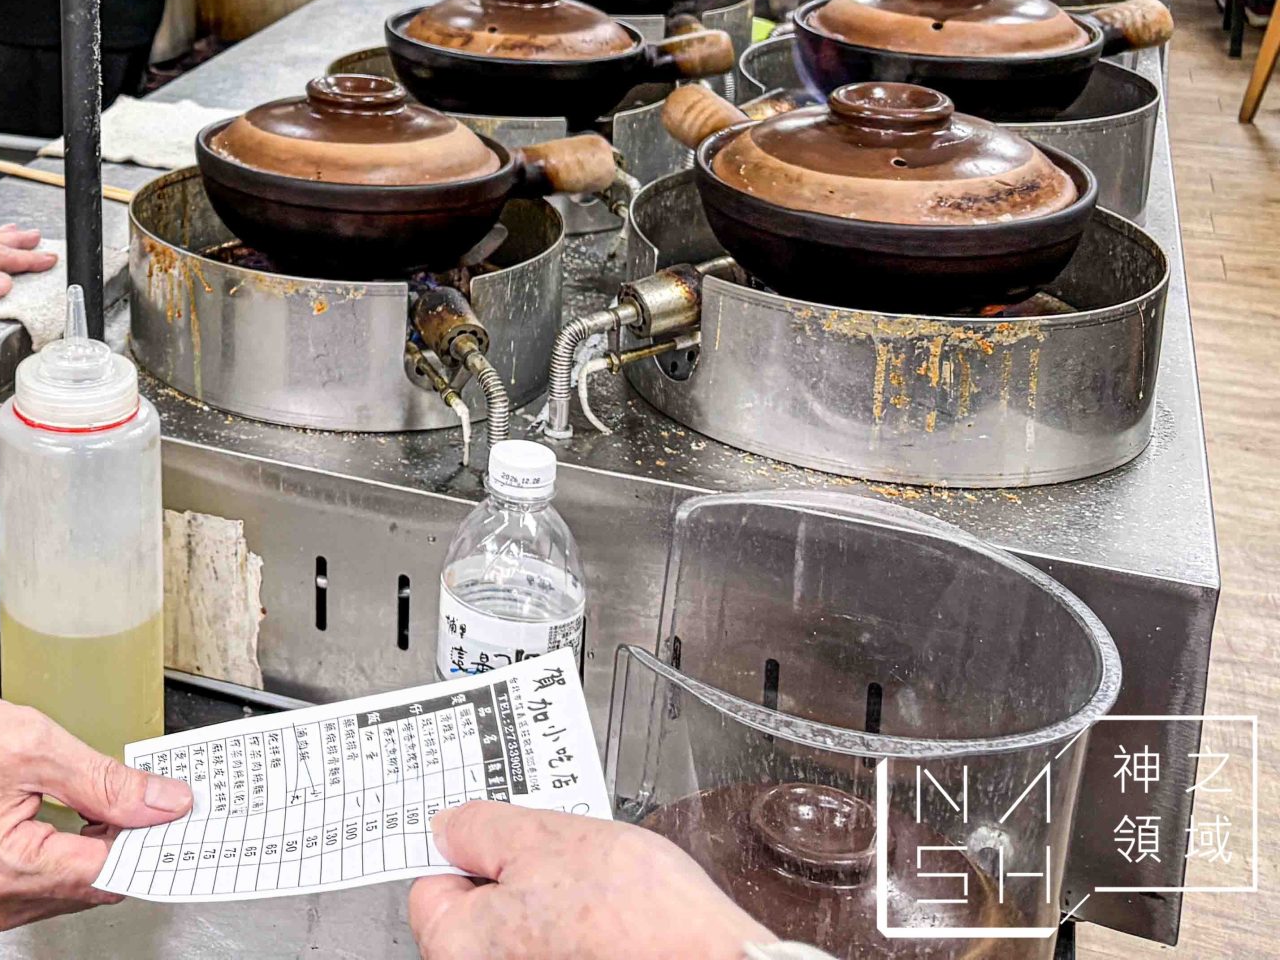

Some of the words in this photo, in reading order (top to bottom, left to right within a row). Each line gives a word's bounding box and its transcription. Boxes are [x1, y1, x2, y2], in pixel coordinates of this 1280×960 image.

[527, 667, 577, 789] 賀加小吃店
[385, 811, 398, 829] 160
[405, 807, 419, 825] 160
[344, 821, 358, 840] 100
[364, 819, 378, 832] 15
[324, 826, 338, 846] 130
[222, 846, 237, 859] 75
[284, 839, 298, 853] 50
[161, 851, 175, 863] 40
[181, 850, 195, 861] 45
[202, 847, 216, 860] 75
